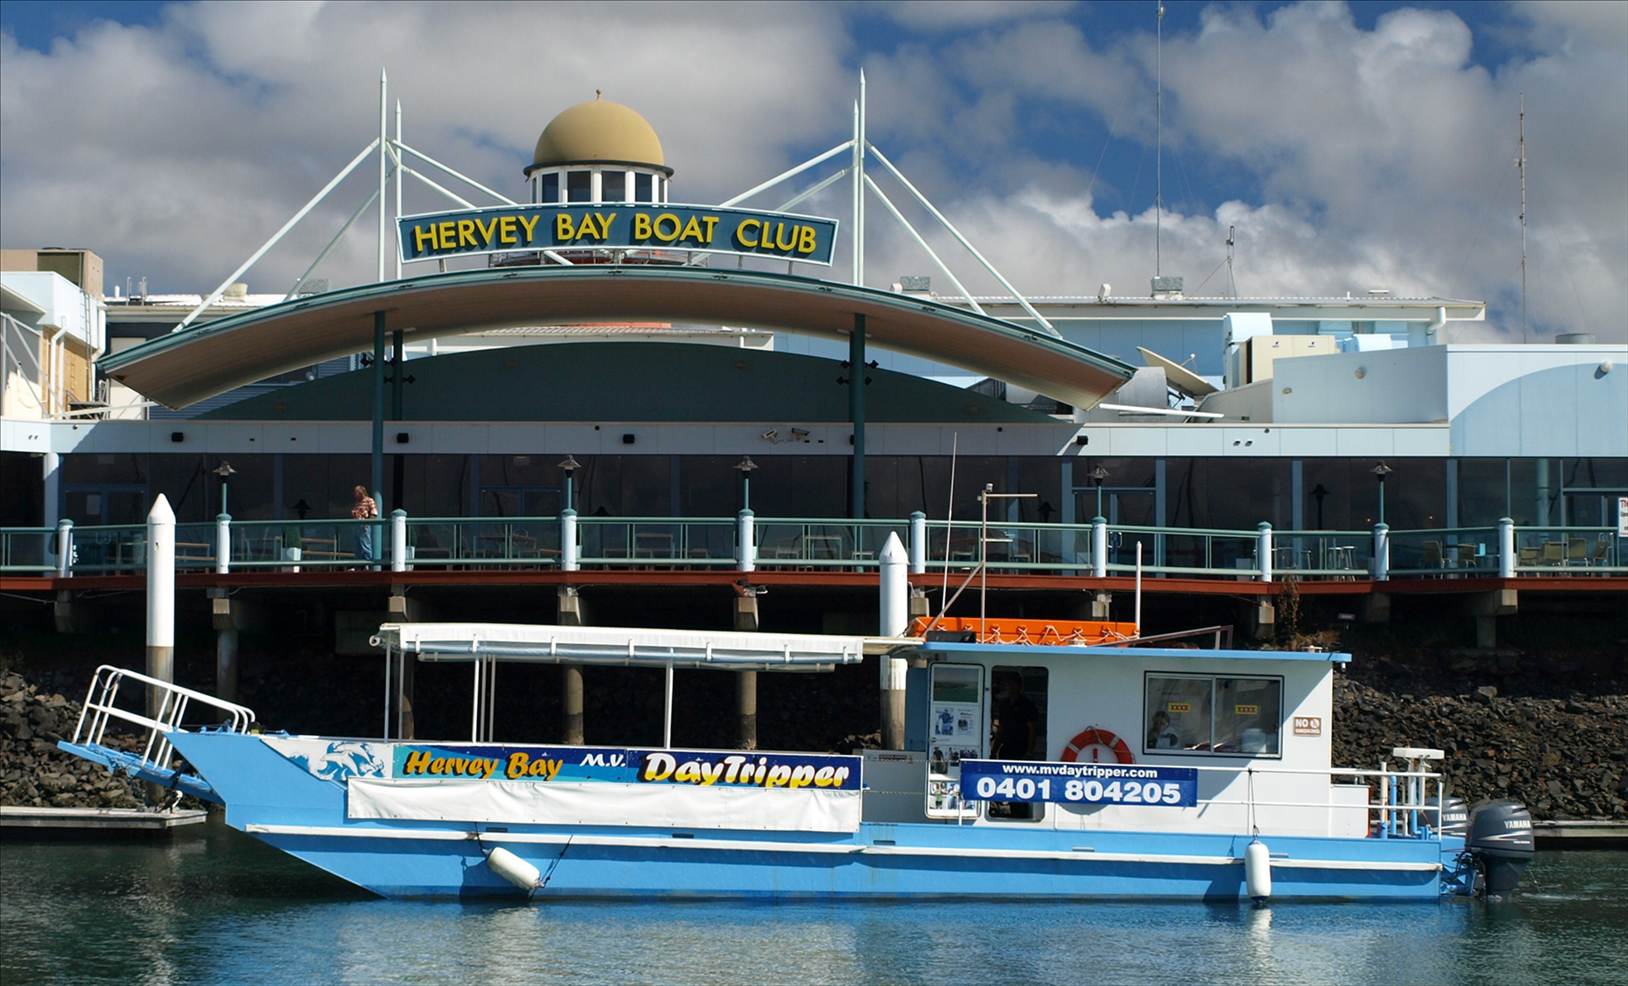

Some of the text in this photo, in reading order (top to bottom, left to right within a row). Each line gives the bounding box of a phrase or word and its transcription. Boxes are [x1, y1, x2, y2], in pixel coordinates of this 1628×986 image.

[414, 212, 817, 255] HERVEY BAY BOAT CLUB
[1295, 718, 1309, 728] NO
[405, 750, 850, 790] Hervey Bay M.V. DayTripper
[1002, 763, 1159, 780] www.mvdaytripper.com
[976, 777, 1182, 805] 0401 804205
[1442, 813, 1467, 821] YAMAHA
[1503, 820, 1532, 830] YAMAHA
